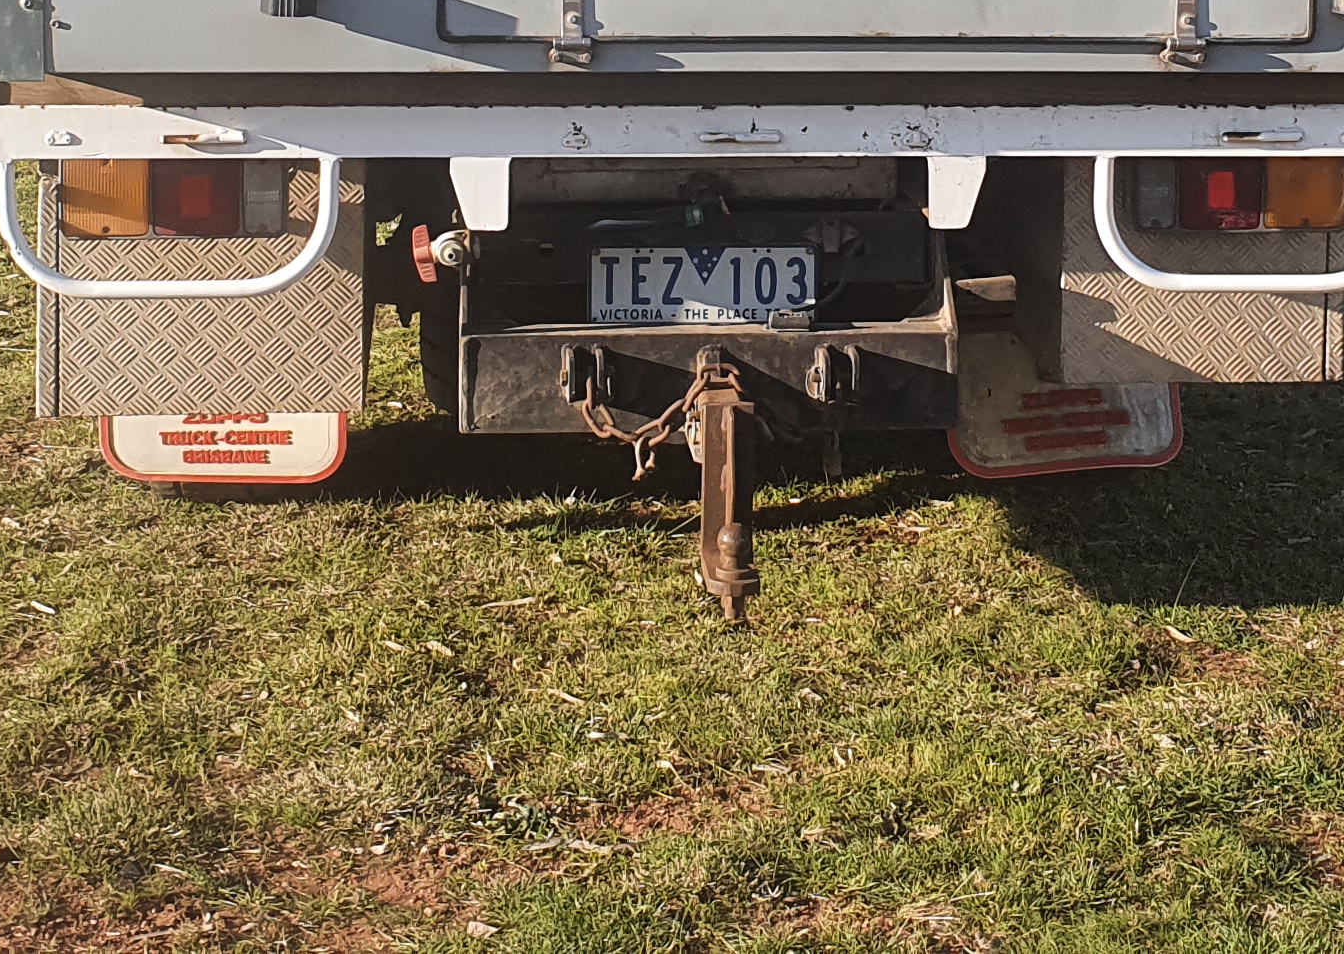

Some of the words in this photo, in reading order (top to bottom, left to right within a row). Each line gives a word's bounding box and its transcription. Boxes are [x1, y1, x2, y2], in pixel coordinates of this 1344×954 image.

[600, 256, 684, 306] TEZ
[729, 256, 808, 306] 103
[600, 308, 663, 321] VICTORIA
[685, 308, 709, 320] THE
[718, 308, 758, 320] PLACE
[182, 449, 271, 464] BRISBANE
